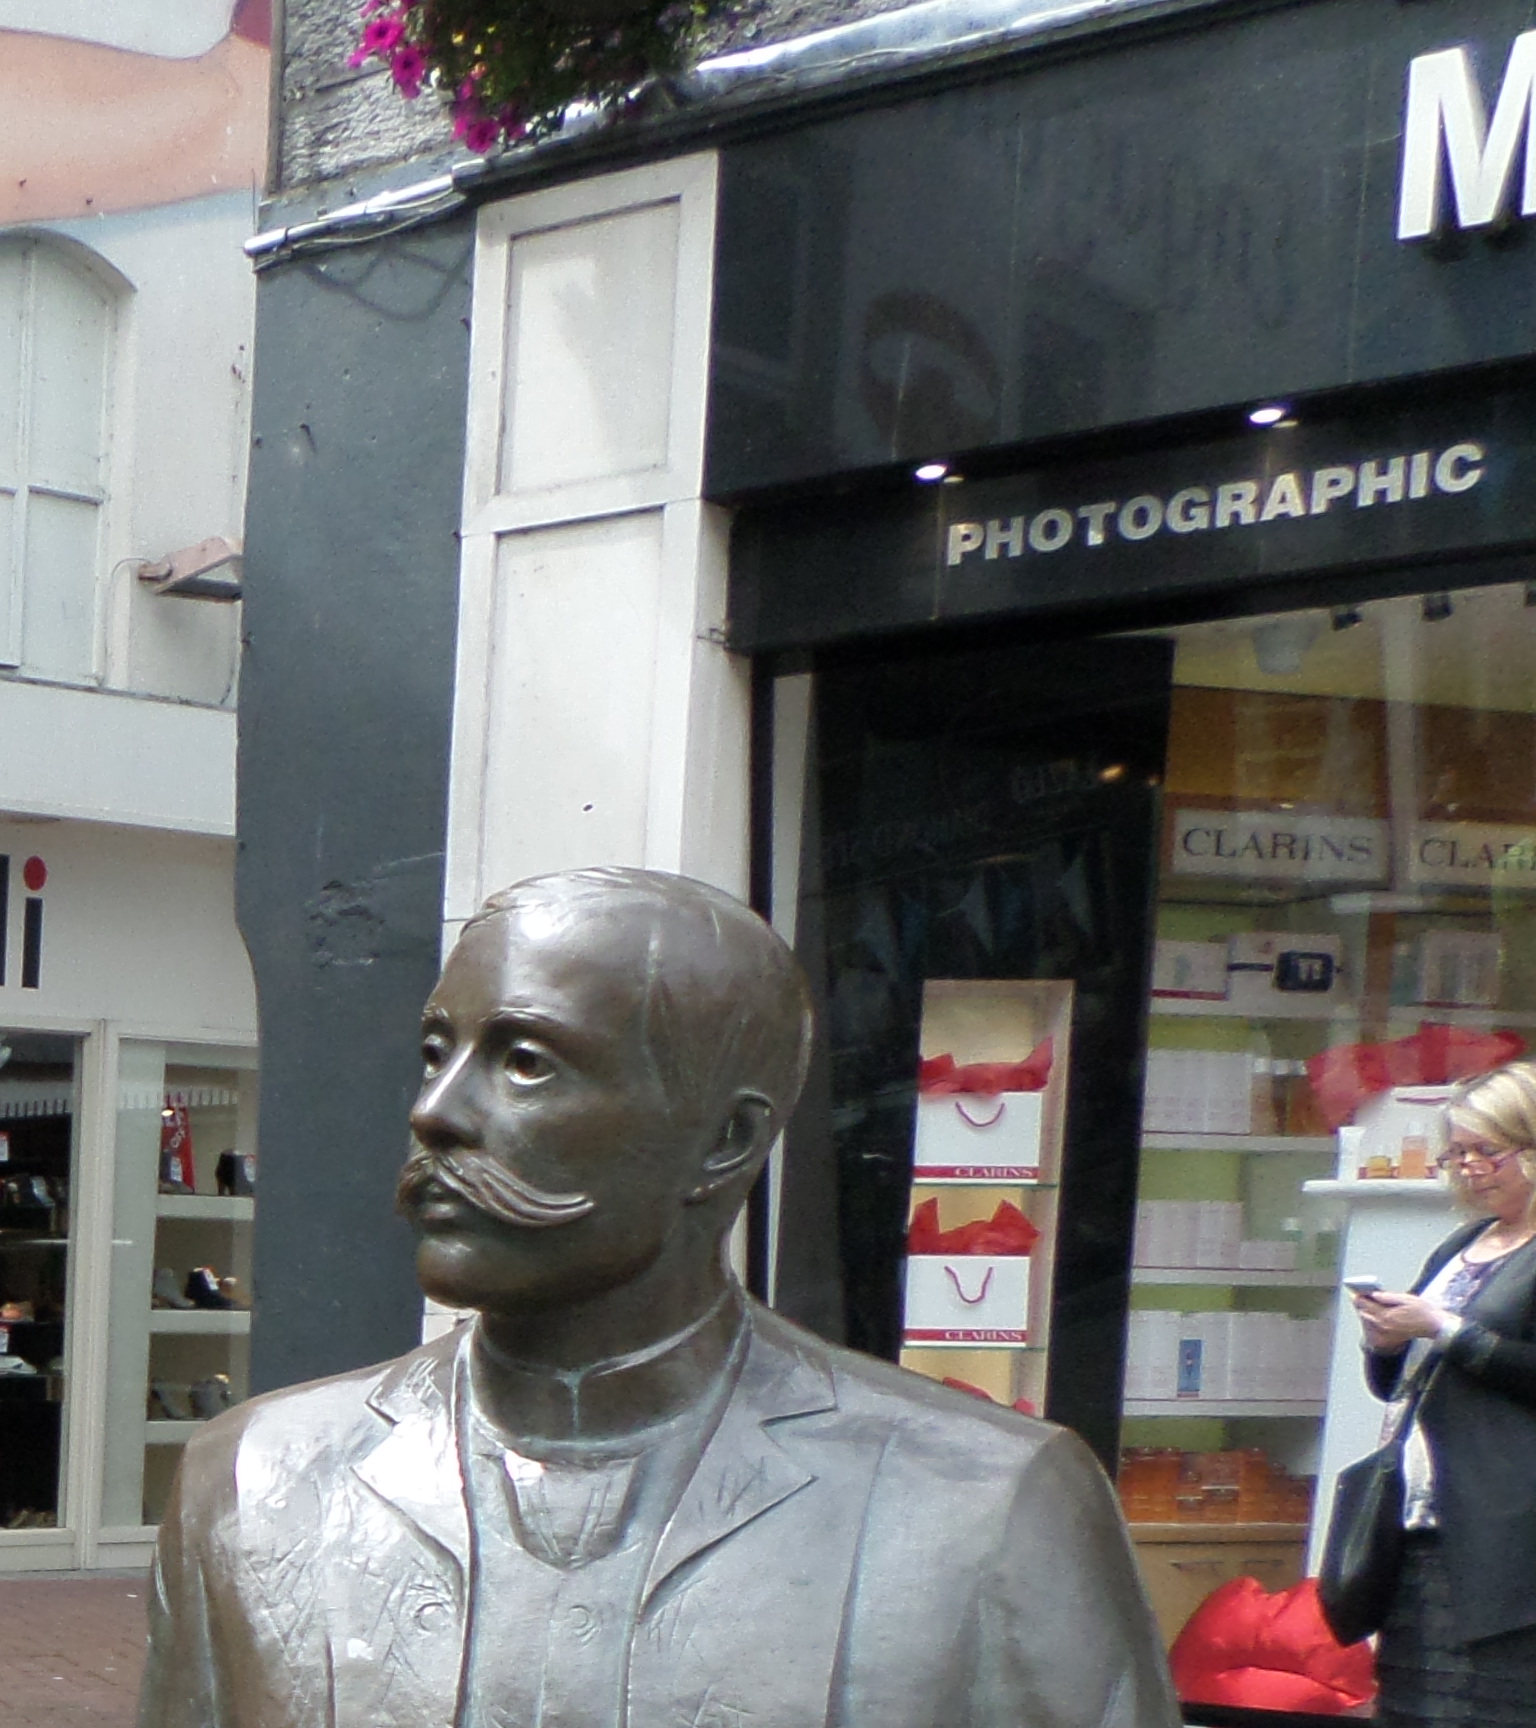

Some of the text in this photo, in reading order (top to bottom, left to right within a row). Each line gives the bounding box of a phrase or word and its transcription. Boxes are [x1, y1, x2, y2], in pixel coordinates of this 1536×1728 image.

[946, 442, 1486, 566] PHOTOGRAPHIC
[1182, 826, 1374, 864] CLARINS
[954, 1166, 1035, 1178] CLARINS
[943, 1330, 1023, 1341] CLARINS
